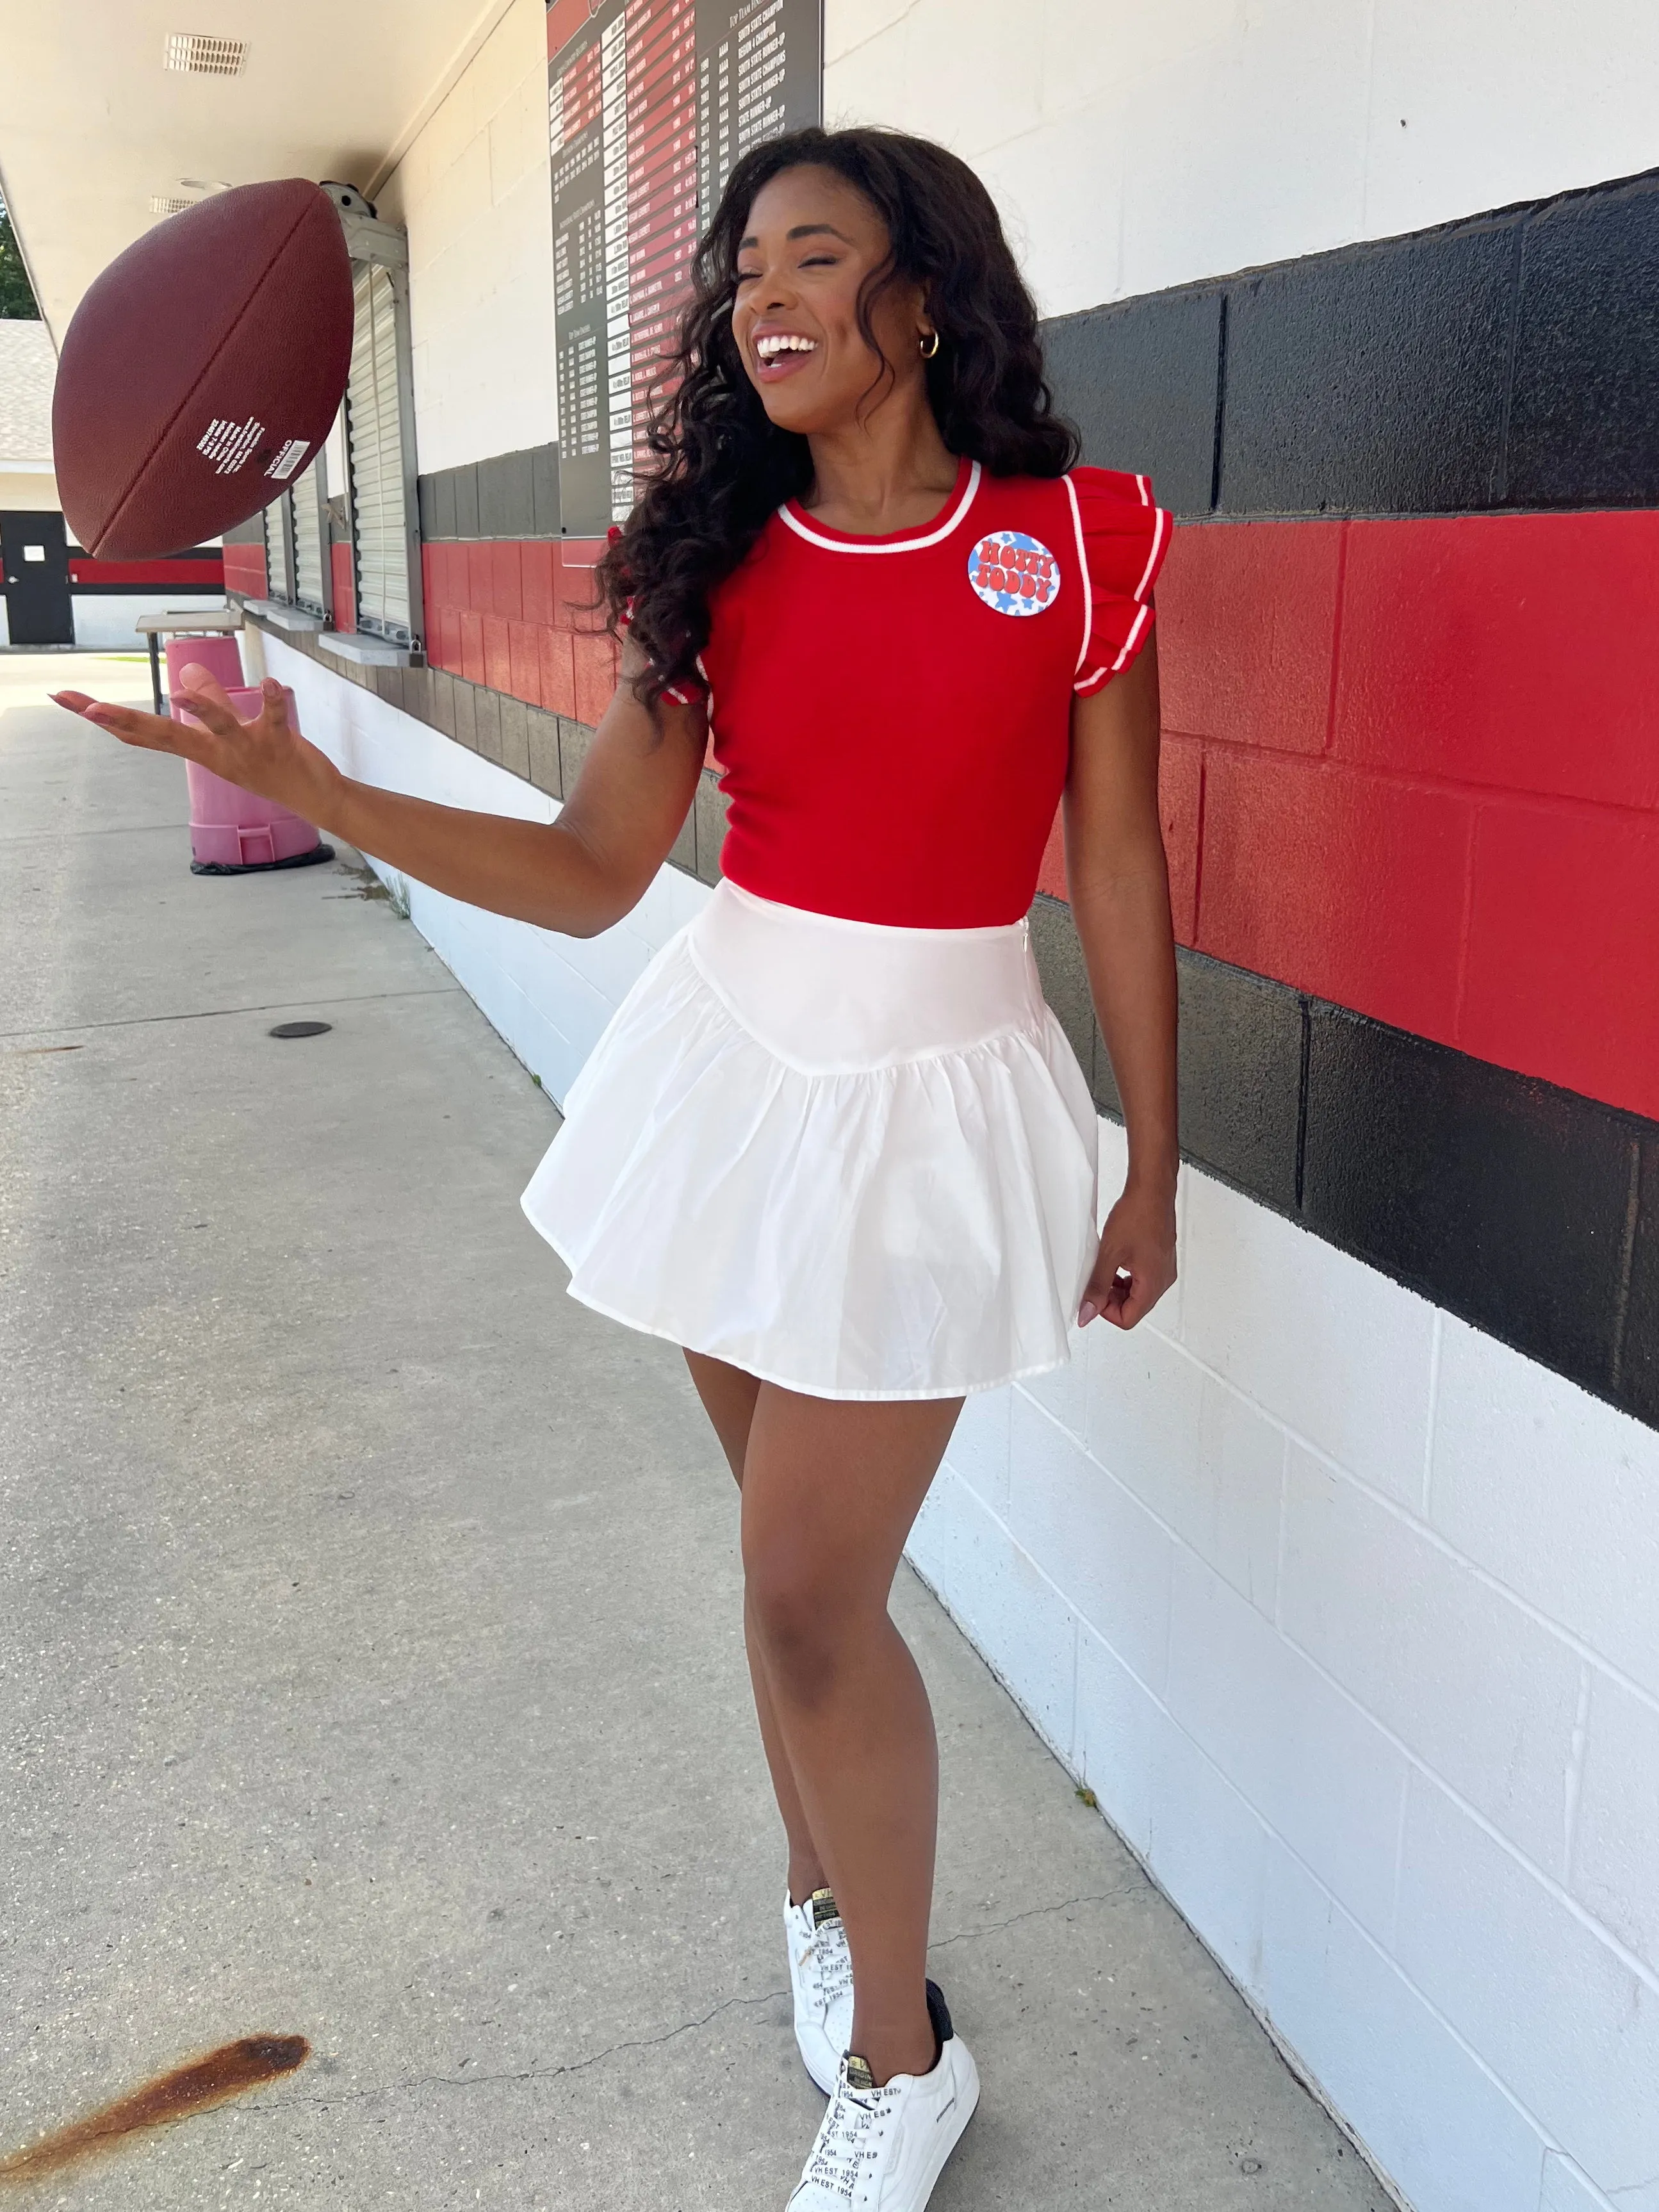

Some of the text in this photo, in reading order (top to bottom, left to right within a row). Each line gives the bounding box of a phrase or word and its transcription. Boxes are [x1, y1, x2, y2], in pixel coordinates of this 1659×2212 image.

[263, 439, 293, 477] OFFICIAL
[979, 541, 1055, 578] HOTTY
[976, 564, 1052, 603] TODDY
[812, 2175, 852, 2198] VH EST 1954
